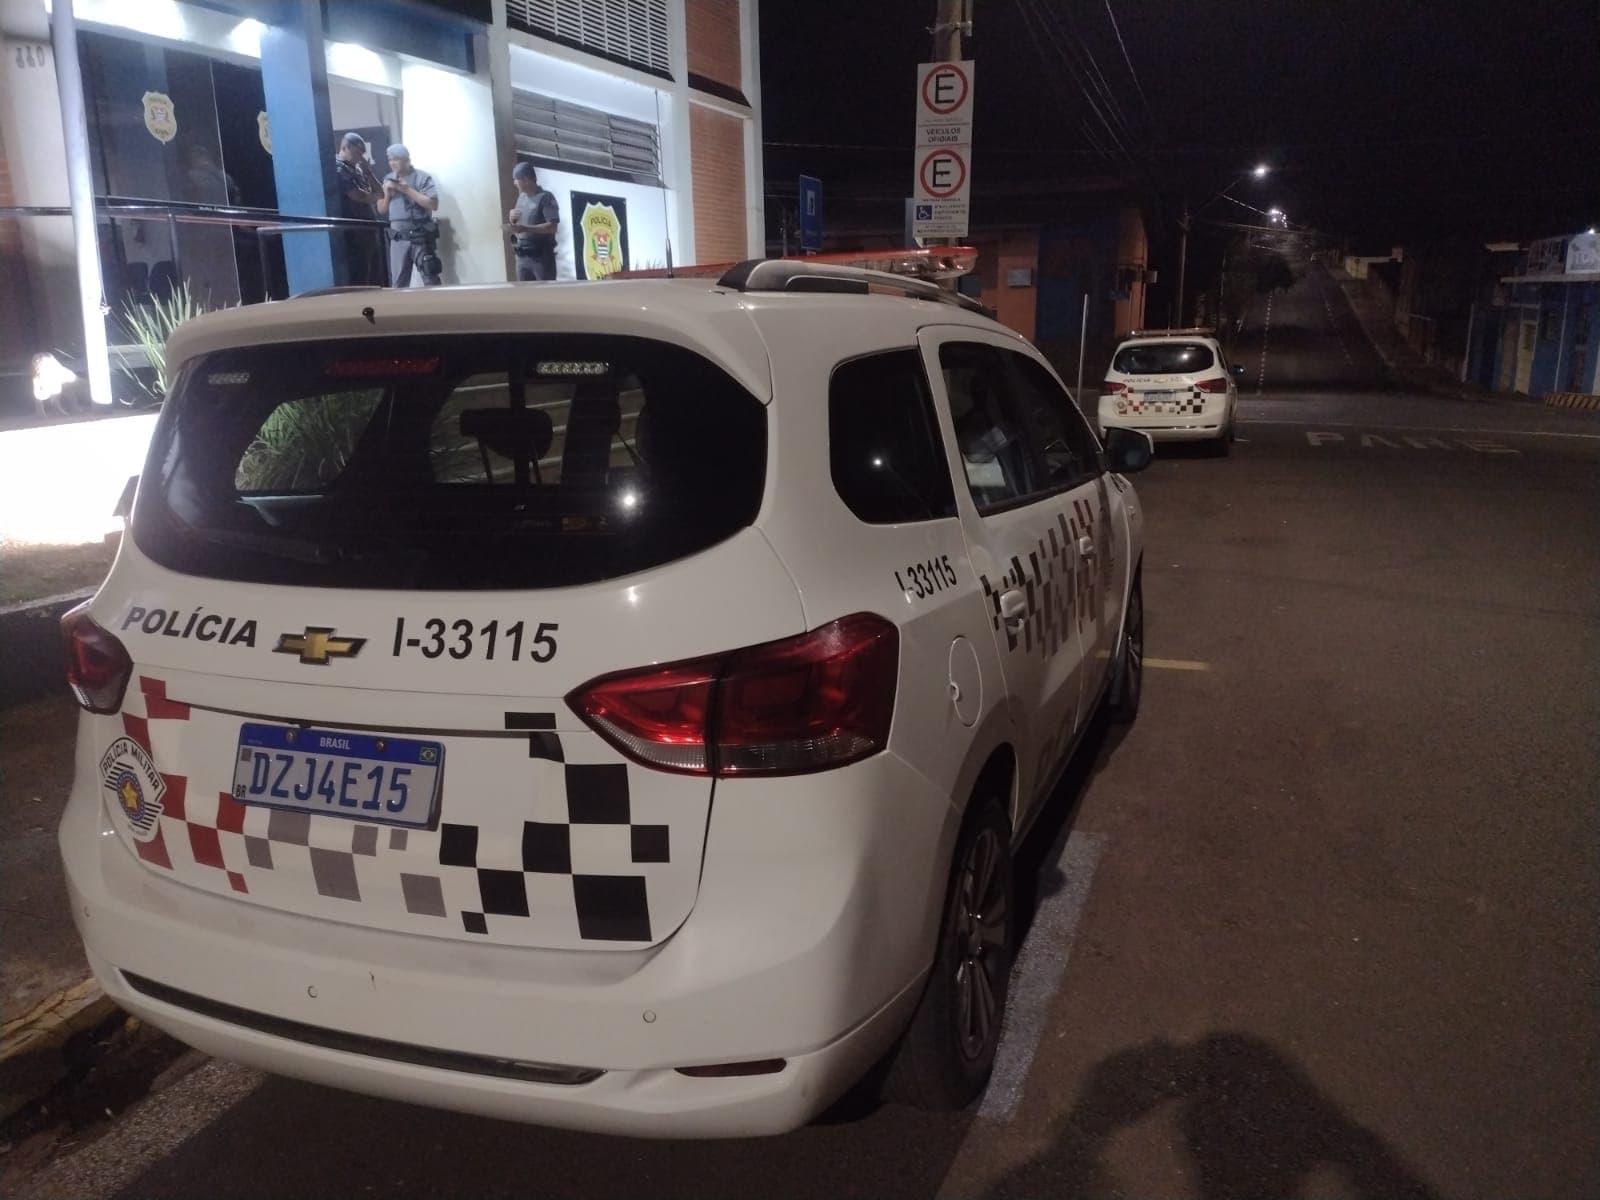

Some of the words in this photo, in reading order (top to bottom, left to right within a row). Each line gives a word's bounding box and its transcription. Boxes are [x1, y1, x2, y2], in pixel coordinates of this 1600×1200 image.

[935, 73, 955, 104] E
[932, 159, 952, 188] E
[895, 554, 957, 599] I-33115
[121, 606, 257, 648] POLÍCIA
[393, 616, 559, 663] I-33115
[320, 736, 351, 750] BRASIL
[131, 745, 160, 791] MILITAR
[248, 751, 412, 813] DZJ4E15
[236, 784, 247, 798] BR
